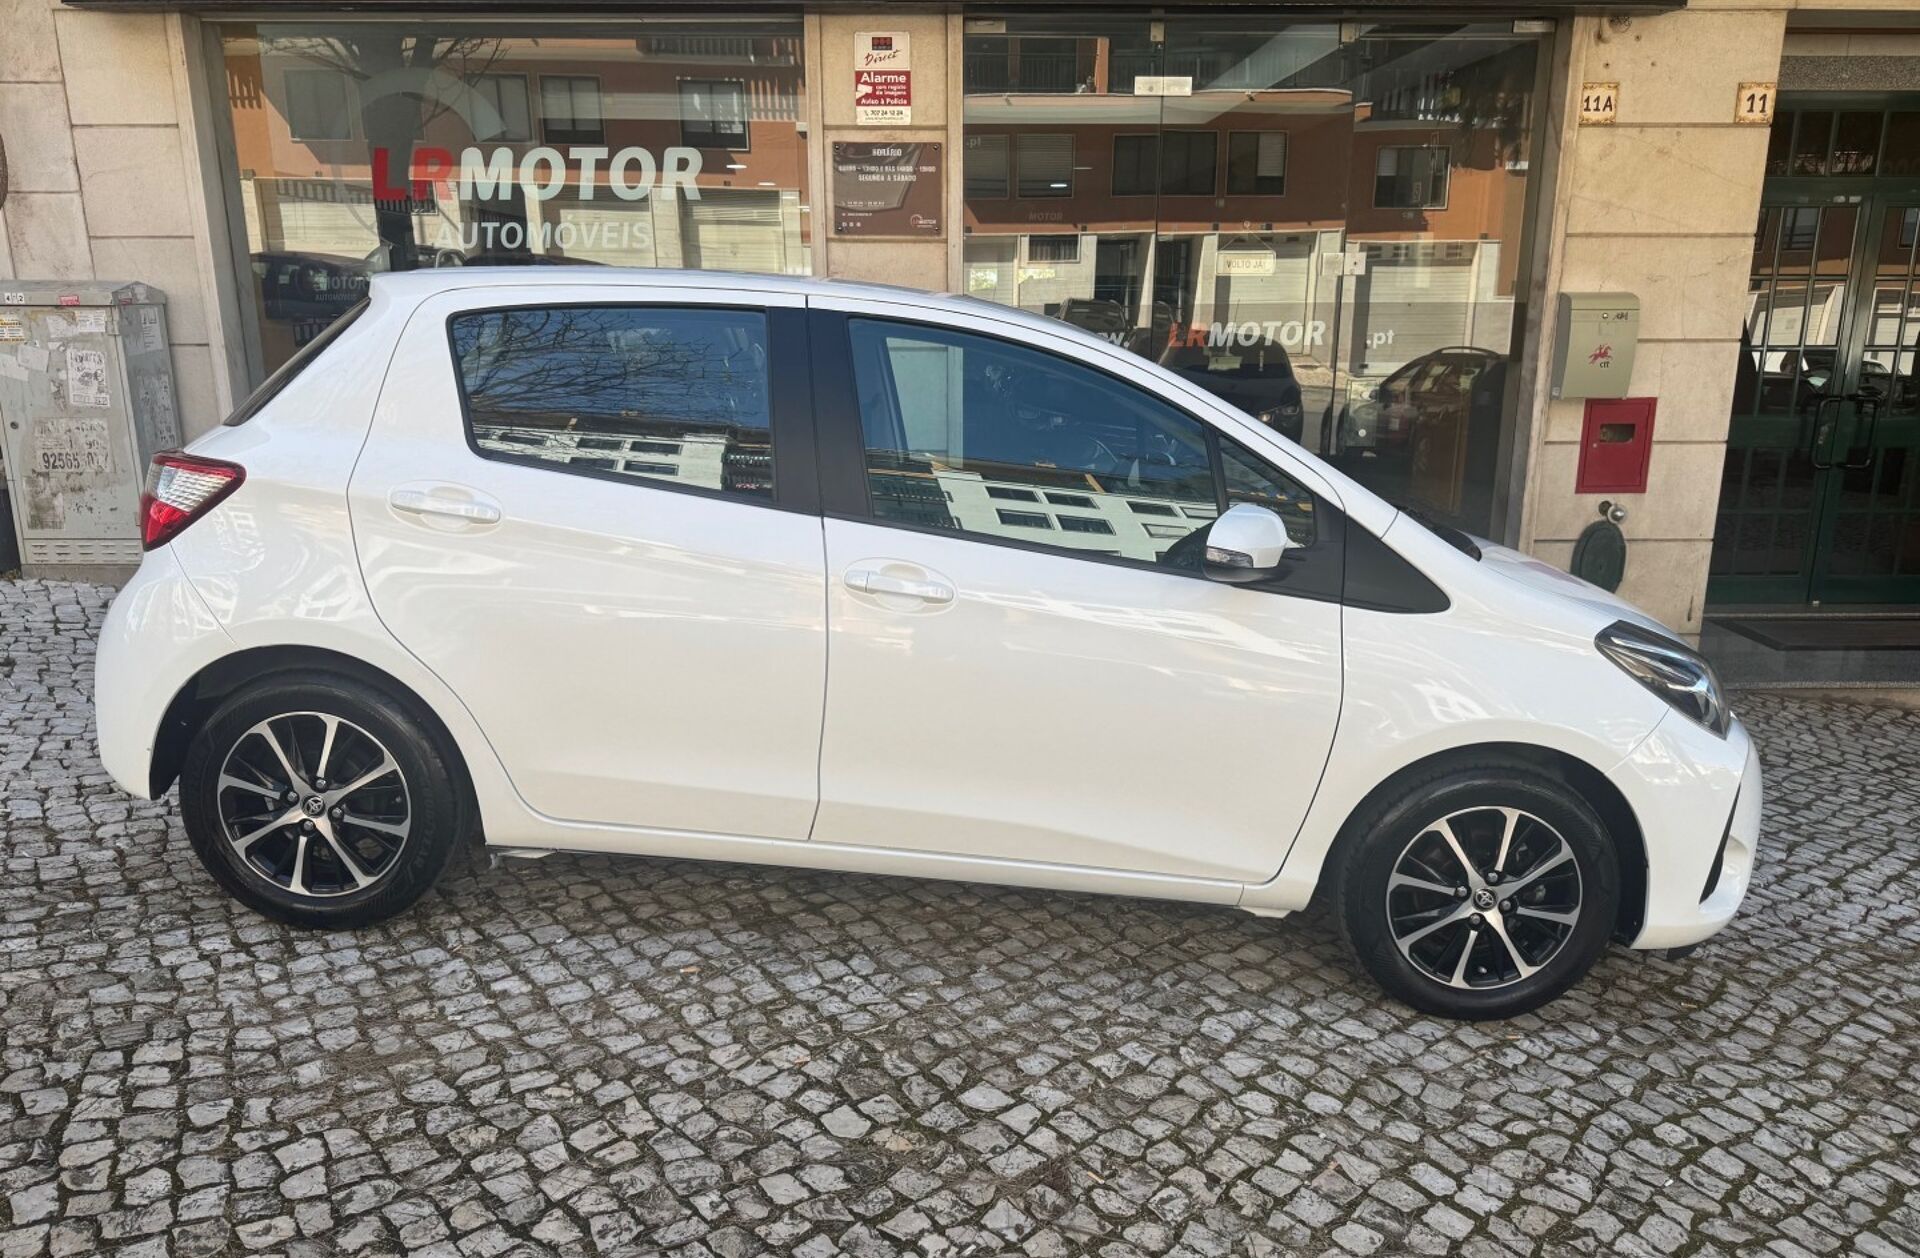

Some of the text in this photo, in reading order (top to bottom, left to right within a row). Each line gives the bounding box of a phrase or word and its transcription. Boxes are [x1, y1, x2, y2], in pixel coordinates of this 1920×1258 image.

[861, 71, 907, 83] Alarme
[1583, 96, 1613, 112] 11A
[1746, 94, 1768, 113] 11
[872, 147, 902, 156] HORÁRIO
[372, 146, 703, 202] LRMOTOR
[434, 213, 651, 249] AUTOMÓVEIS
[1167, 320, 1326, 348] LRMOTOR
[1366, 329, 1395, 349] .pt
